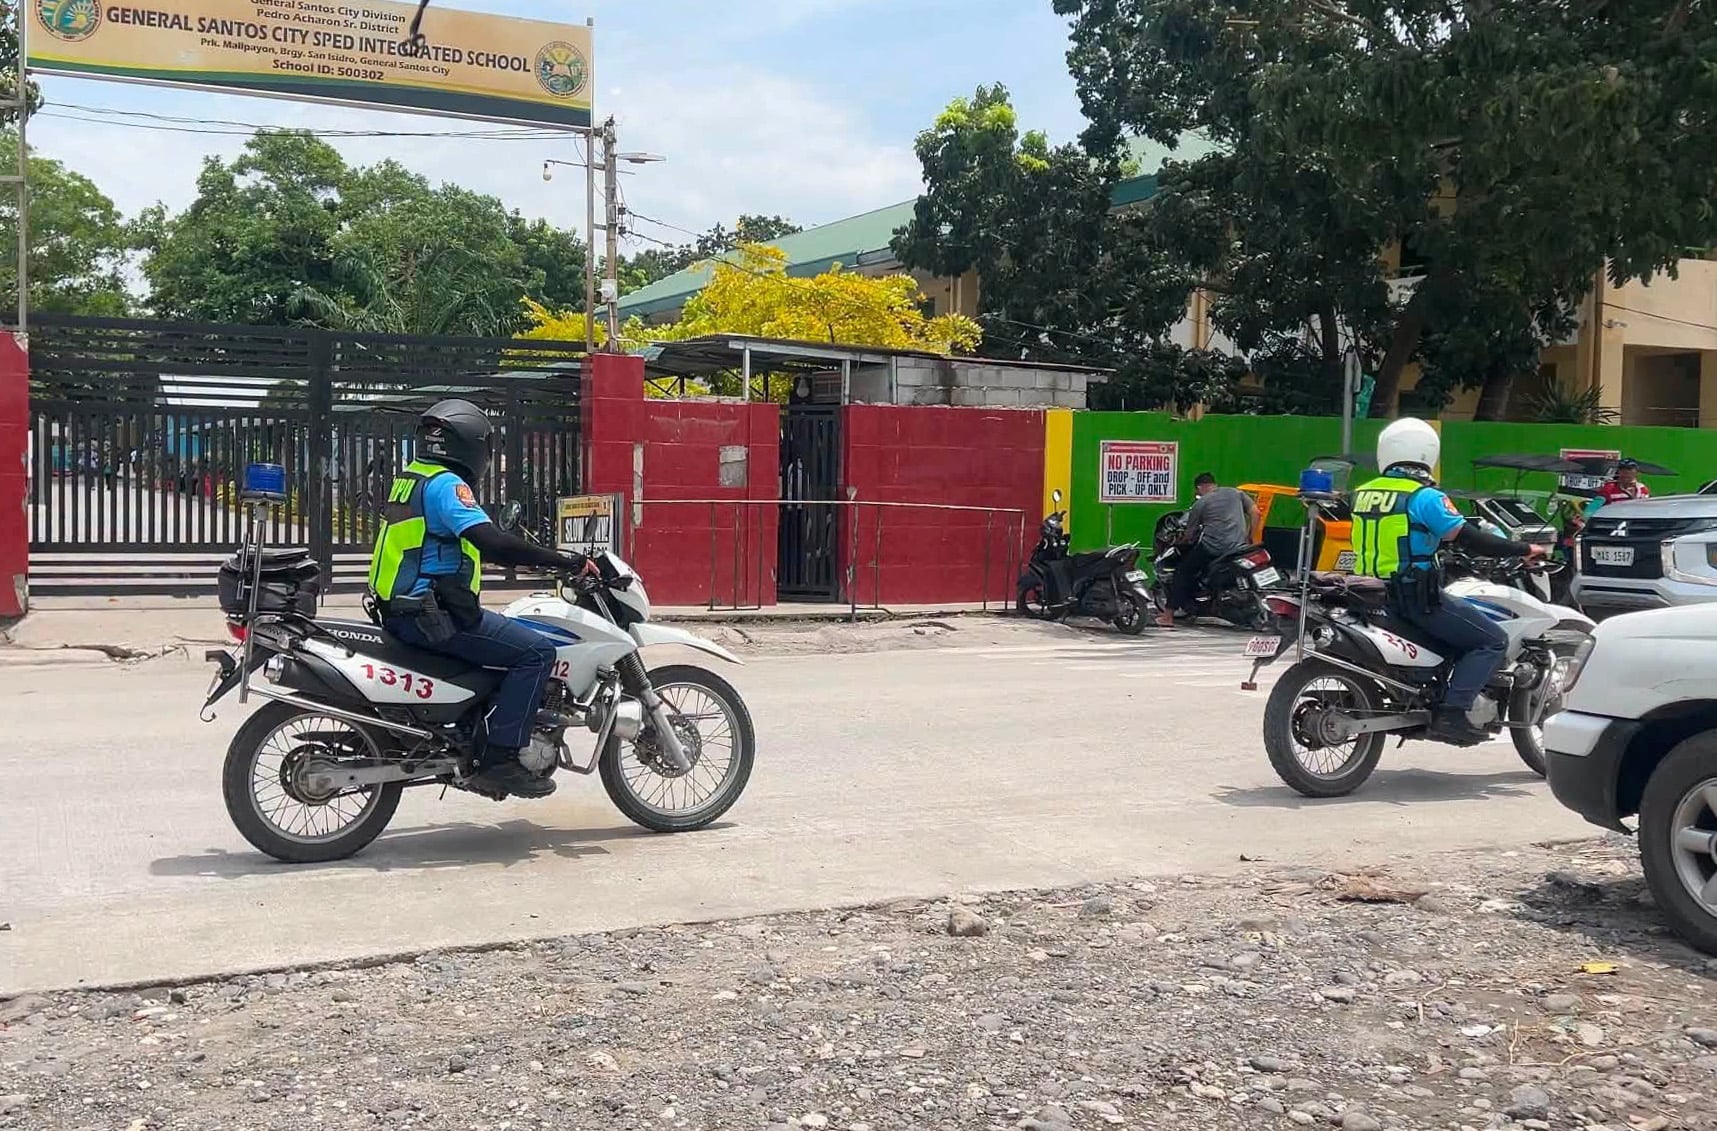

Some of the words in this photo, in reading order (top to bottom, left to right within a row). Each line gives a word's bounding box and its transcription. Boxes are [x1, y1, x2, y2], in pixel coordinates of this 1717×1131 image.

[257, 9, 290, 20] Pedro
[293, 13, 340, 27] Acharon
[343, 19, 357, 29] Sr.
[360, 22, 399, 34] District
[298, 1, 334, 14] Santos
[338, 7, 360, 19] City
[362, 10, 405, 23] Division
[106, 6, 193, 32] GENERAL
[197, 16, 267, 40] SANTOS
[272, 26, 309, 45] CITY
[313, 31, 354, 50] SPED
[467, 50, 531, 73] SCHOOL
[273, 59, 314, 72] School
[317, 65, 335, 75] ID:
[337, 67, 385, 81] 500302
[280, 47, 306, 59] Brgy.
[308, 51, 326, 60] San
[328, 53, 358, 64] Isidro,
[360, 57, 397, 68] General
[399, 61, 430, 72] Santos
[432, 65, 450, 76] City
[1108, 454, 1122, 470] NO
[1126, 455, 1170, 471] PARKING
[1107, 471, 1129, 483] DROP
[1137, 471, 1152, 483] OFF
[1153, 471, 1170, 483] and
[1108, 483, 1127, 495] PICK
[1135, 484, 1146, 496] UP
[1148, 484, 1168, 496] ONLY
[1353, 491, 1398, 513] MPU
[326, 628, 385, 645] HONDA
[360, 663, 434, 699] 1313
